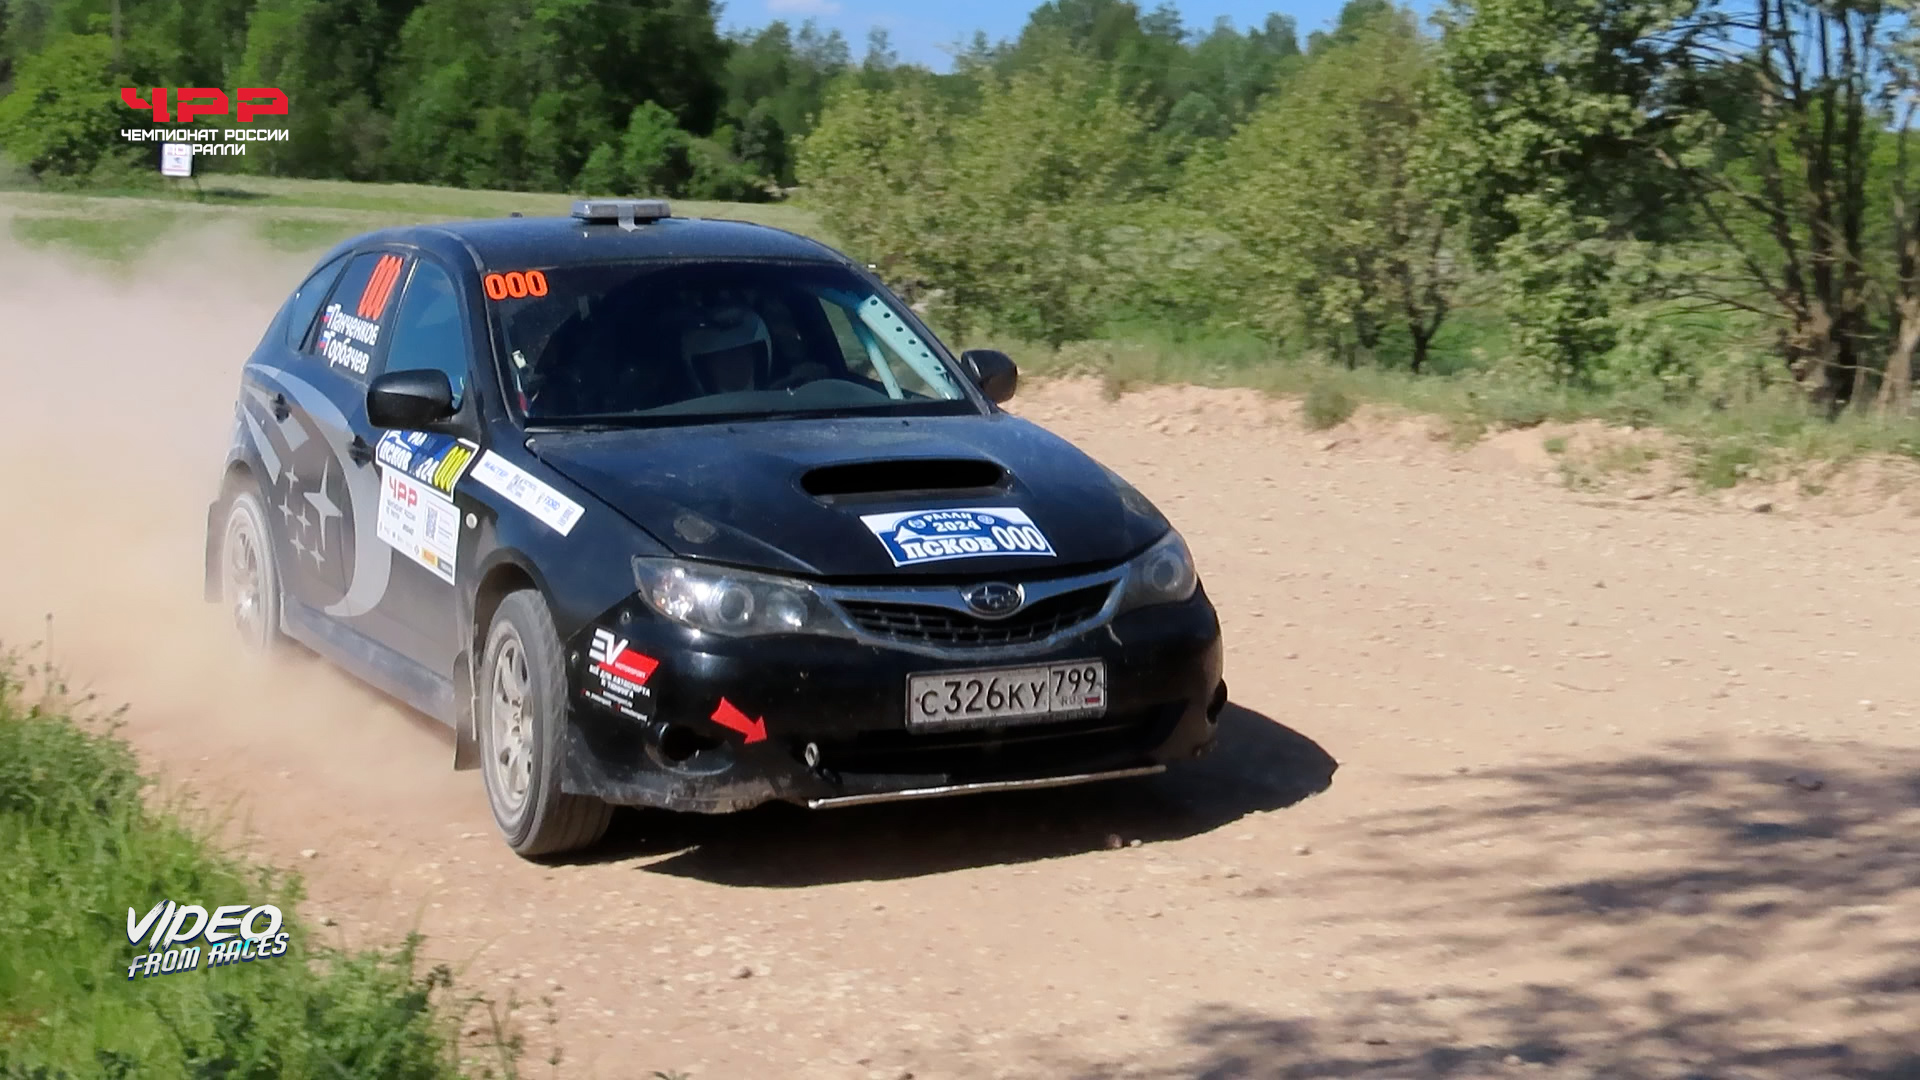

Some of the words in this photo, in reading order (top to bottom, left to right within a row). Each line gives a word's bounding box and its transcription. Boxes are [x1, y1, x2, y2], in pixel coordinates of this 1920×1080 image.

[357, 254, 404, 321] 000
[485, 270, 548, 300] 000
[327, 303, 380, 346] Панченков
[322, 331, 370, 374] Горбачев
[379, 440, 413, 472] ПСКОВ
[388, 475, 418, 508] ЧРР
[923, 512, 973, 522] РАЛЛИ
[932, 520, 982, 532] 2024
[900, 536, 998, 560] ПСКОВ
[990, 525, 1046, 551] 000
[1052, 666, 1098, 696] 799
